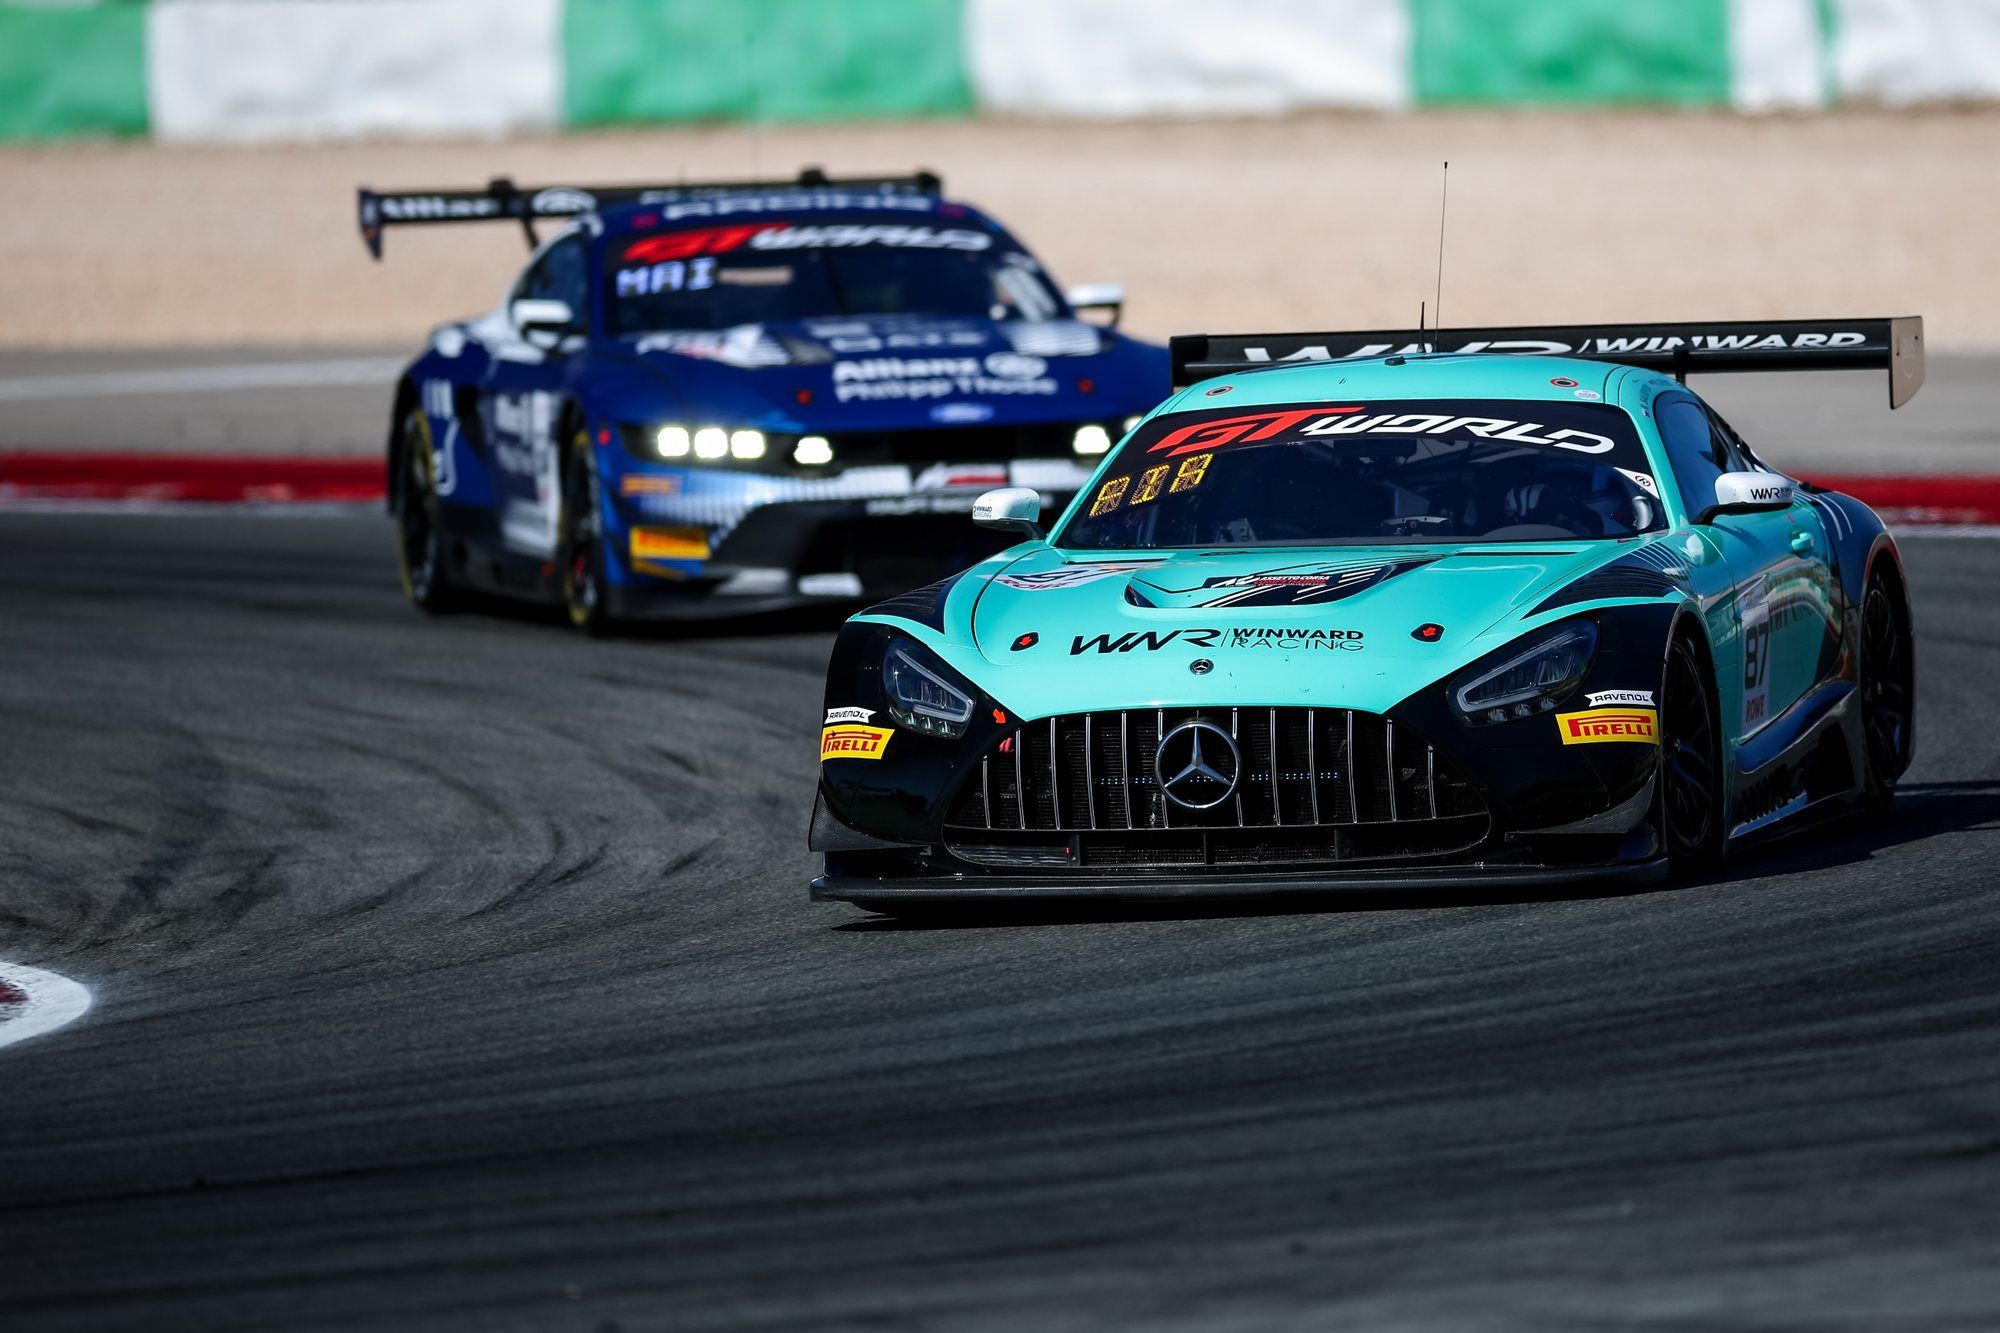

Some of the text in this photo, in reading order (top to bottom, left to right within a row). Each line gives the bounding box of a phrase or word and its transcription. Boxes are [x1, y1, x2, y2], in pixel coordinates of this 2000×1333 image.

[381, 197, 501, 218] Allian
[616, 256, 717, 298] MAI
[1596, 332, 1866, 353] WINWARD
[1146, 406, 1615, 458] GT WORLD
[1750, 487, 1781, 500] WNR
[1069, 628, 1364, 656] WNR WINWARD
[1230, 638, 1365, 651] RACING
[1744, 621, 1769, 690] 87
[1594, 693, 1648, 702] RAVENOL
[828, 710, 866, 719] RAVENOL
[1567, 715, 1652, 737] PIRELLI
[822, 731, 883, 753] PIRELLI
